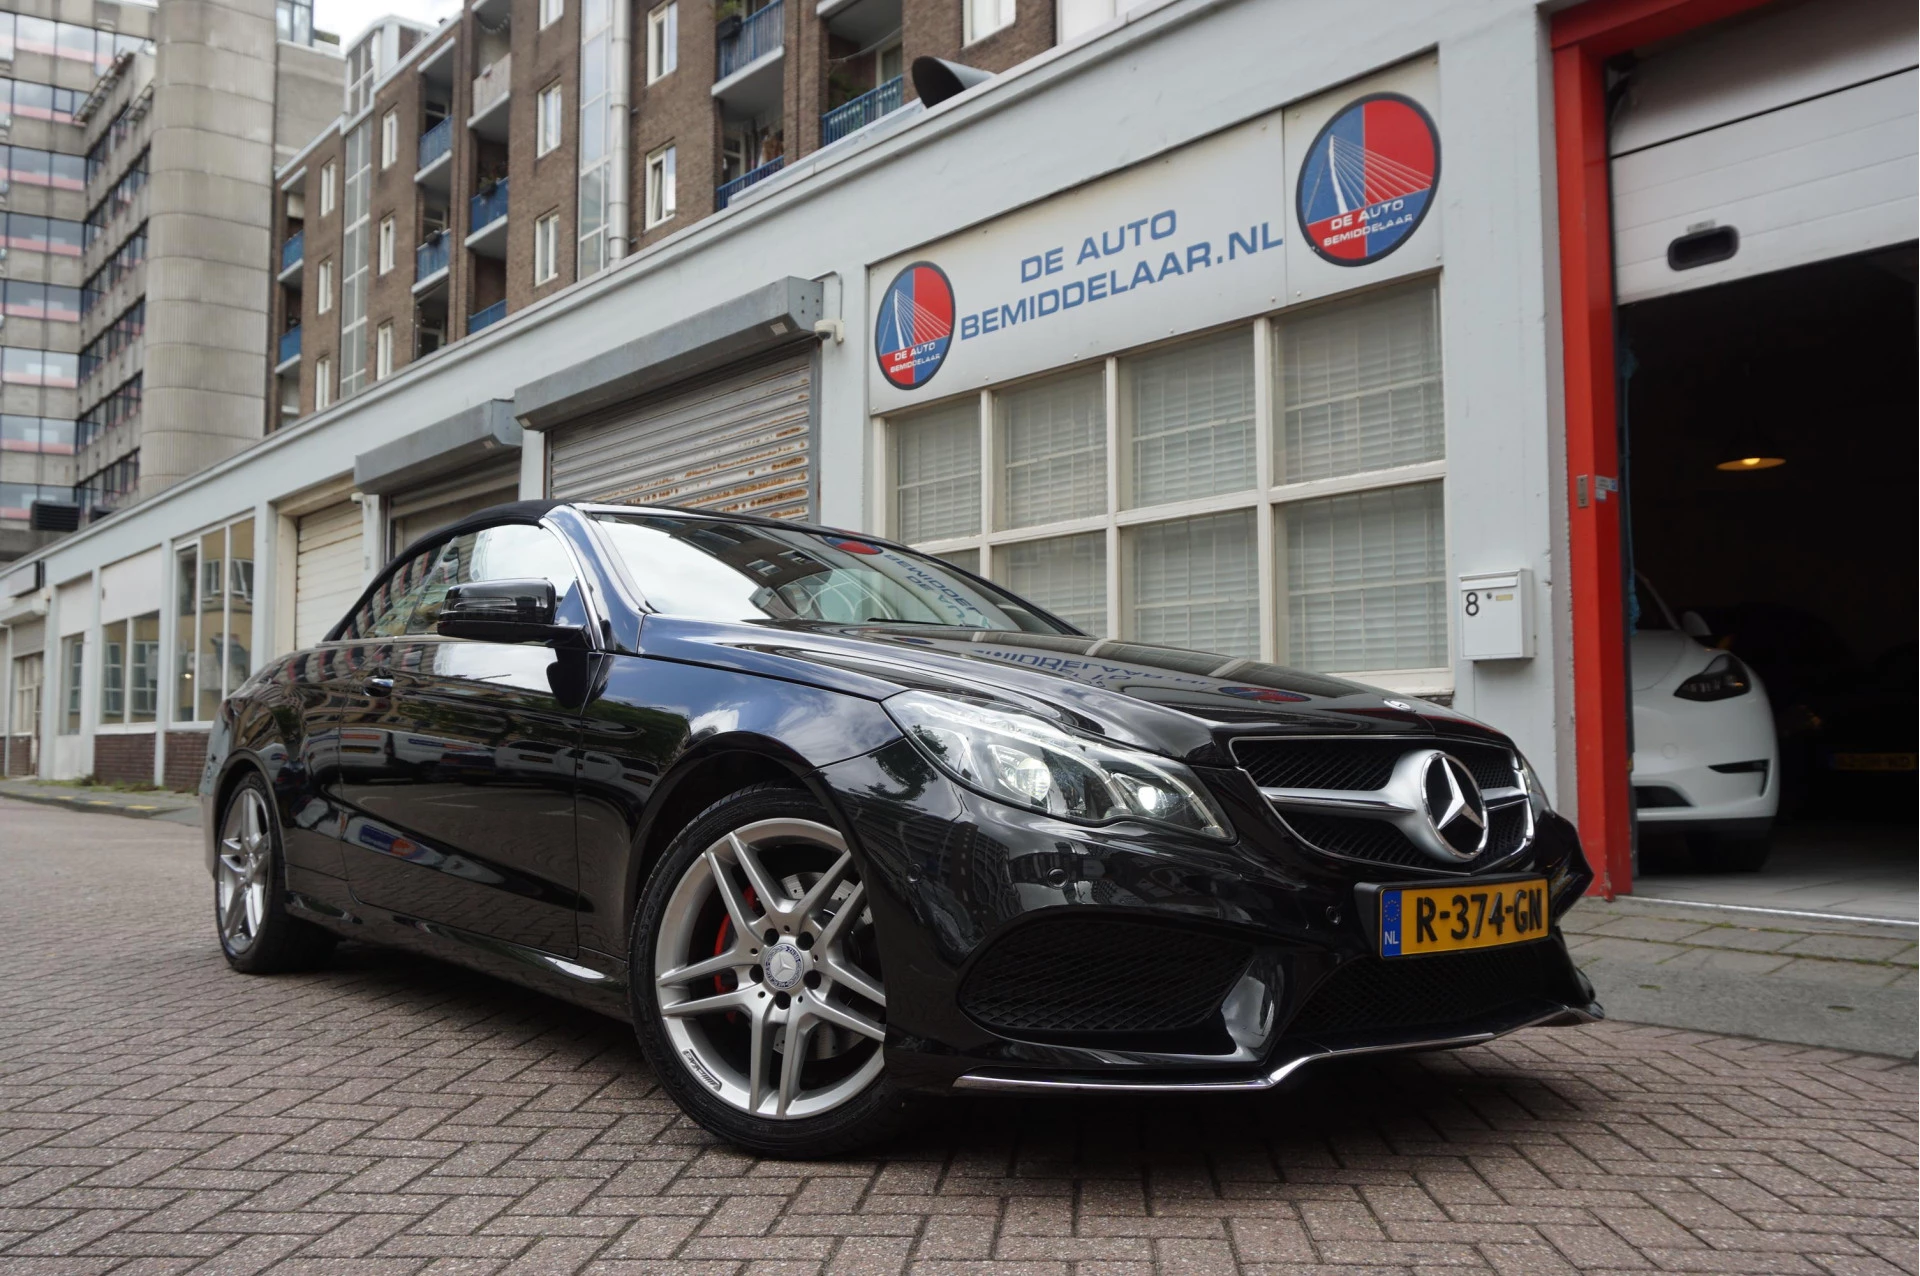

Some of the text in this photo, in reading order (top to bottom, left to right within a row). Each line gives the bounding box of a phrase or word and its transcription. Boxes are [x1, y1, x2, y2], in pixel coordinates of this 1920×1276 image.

[1323, 213, 1413, 247] BEMIDDELAAR
[1331, 199, 1404, 230] DE AUTO
[1021, 209, 1176, 284] DE AUTO
[961, 221, 1283, 341] BEMIDDELAAR.NL
[890, 353, 940, 373] BEMIDDELAAR
[894, 341, 936, 361] DE AUTO
[1465, 591, 1480, 616] 8
[1416, 888, 1542, 944] R-374-GN
[1384, 930, 1399, 945] NL
